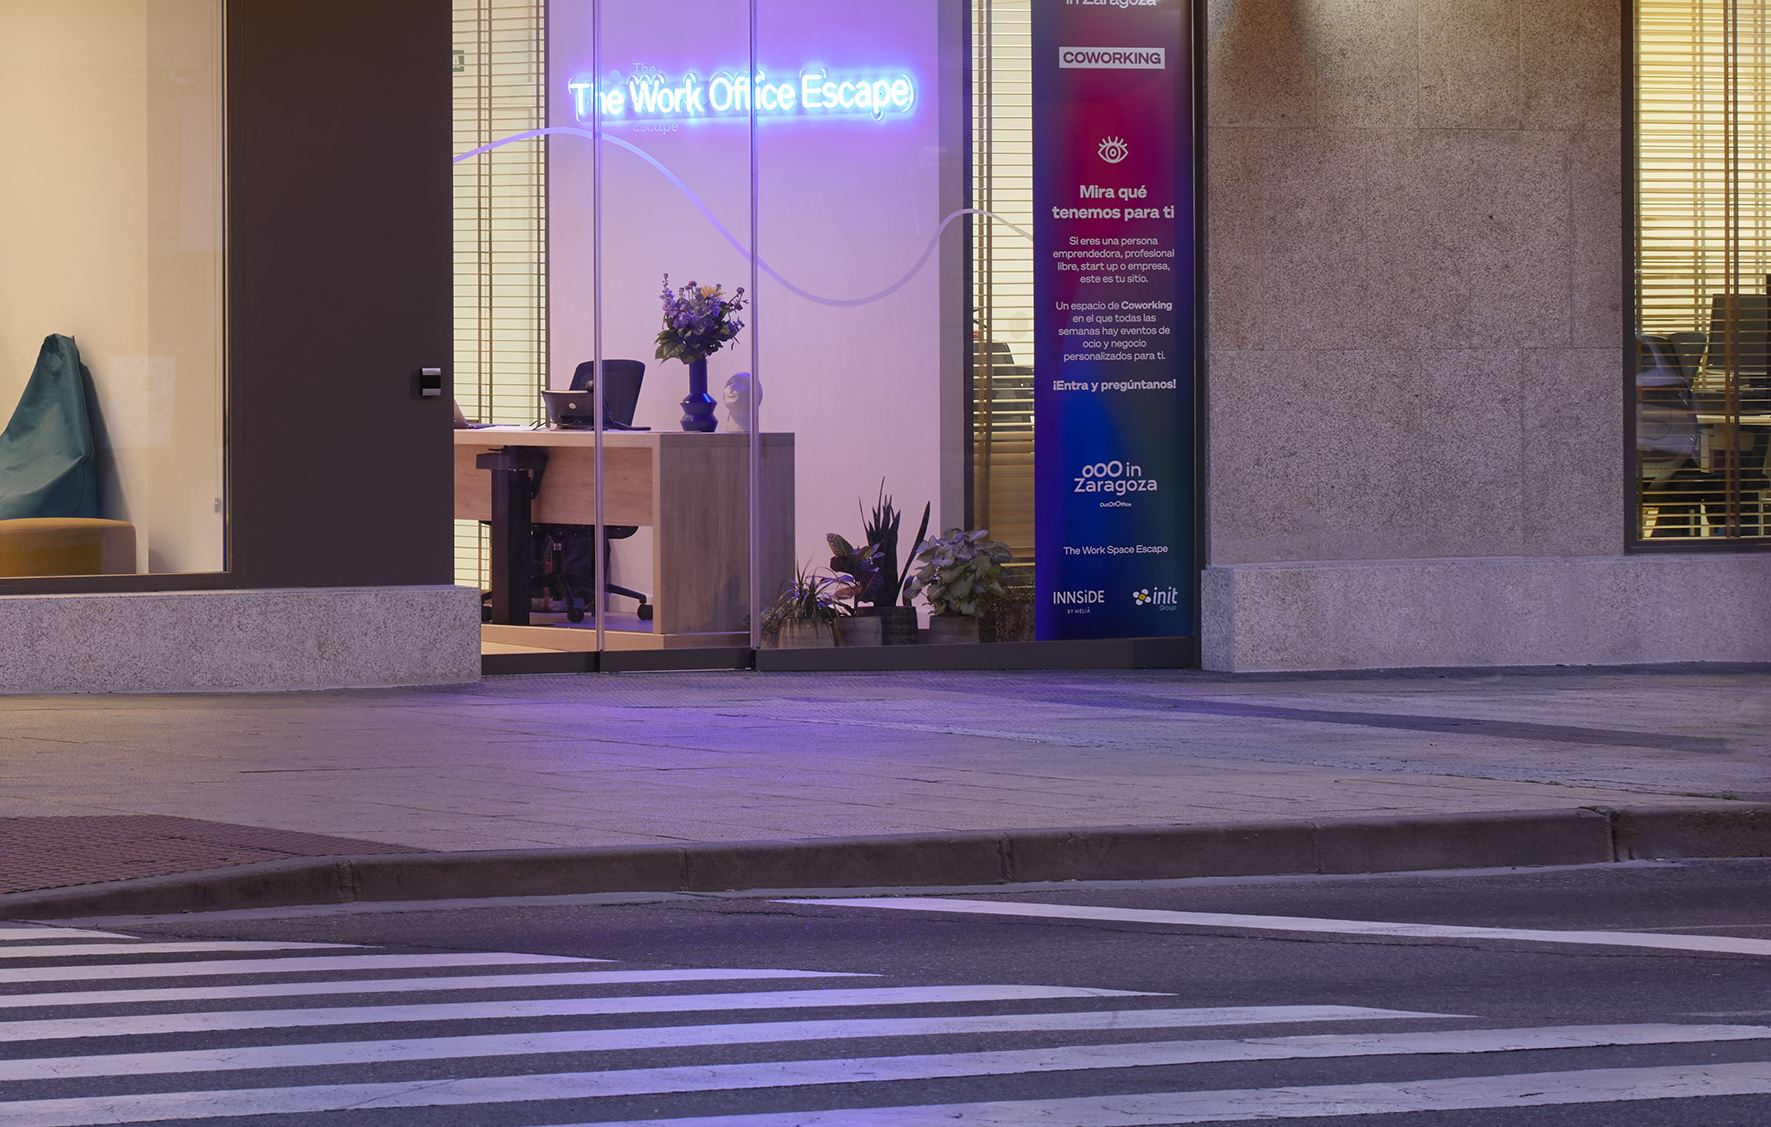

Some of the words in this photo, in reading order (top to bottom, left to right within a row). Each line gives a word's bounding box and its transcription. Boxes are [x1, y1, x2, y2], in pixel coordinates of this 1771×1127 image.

[1062, 51, 1162, 65] COWORKING
[568, 81, 625, 116] The
[629, 78, 704, 114] Work
[709, 76, 795, 112] Office
[801, 73, 911, 115] Escape
[1079, 185, 1115, 198] Mira
[1118, 185, 1147, 201] qué
[1052, 206, 1121, 218] tenemos
[1124, 207, 1160, 221] para
[1163, 205, 1175, 218] ti
[1069, 236, 1078, 245] Si
[1121, 238, 1158, 247] persona
[1053, 249, 1123, 259] emprendedora,
[1124, 249, 1175, 259] profesional
[1057, 262, 1079, 271] libre,
[1081, 262, 1104, 270] start
[1106, 263, 1118, 272] up
[1128, 263, 1170, 271] empresa,
[1080, 274, 1101, 283] este
[1115, 274, 1125, 283] tu
[1127, 274, 1149, 283] sitio.
[1055, 301, 1069, 310] Un
[1071, 301, 1106, 312] espacio
[1108, 301, 1119, 310] de
[1121, 301, 1172, 311] Coworking
[1086, 314, 1094, 322] el
[1095, 315, 1113, 324] que
[1115, 314, 1141, 322] todas
[1143, 314, 1156, 322] las
[1058, 328, 1100, 336] semanas
[1102, 327, 1119, 337] hay
[1120, 327, 1157, 335] eventos
[1158, 326, 1170, 334] de
[1082, 339, 1102, 348] ocio
[1103, 340, 1109, 349] y
[1111, 339, 1147, 349] negocio
[1063, 352, 1132, 362] personalizados
[1134, 353, 1155, 361] para
[1157, 351, 1166, 360] ti.
[1053, 380, 1089, 391] ¡Entra
[1091, 381, 1098, 392] y
[1101, 379, 1177, 392] pregúntanos!
[1126, 462, 1141, 477] in
[1074, 478, 1158, 496] Zaragoza
[1063, 546, 1080, 555] The
[1082, 546, 1105, 554] Work
[1107, 545, 1134, 555] Space
[1136, 545, 1168, 554] Escape
[1152, 586, 1178, 604] init
